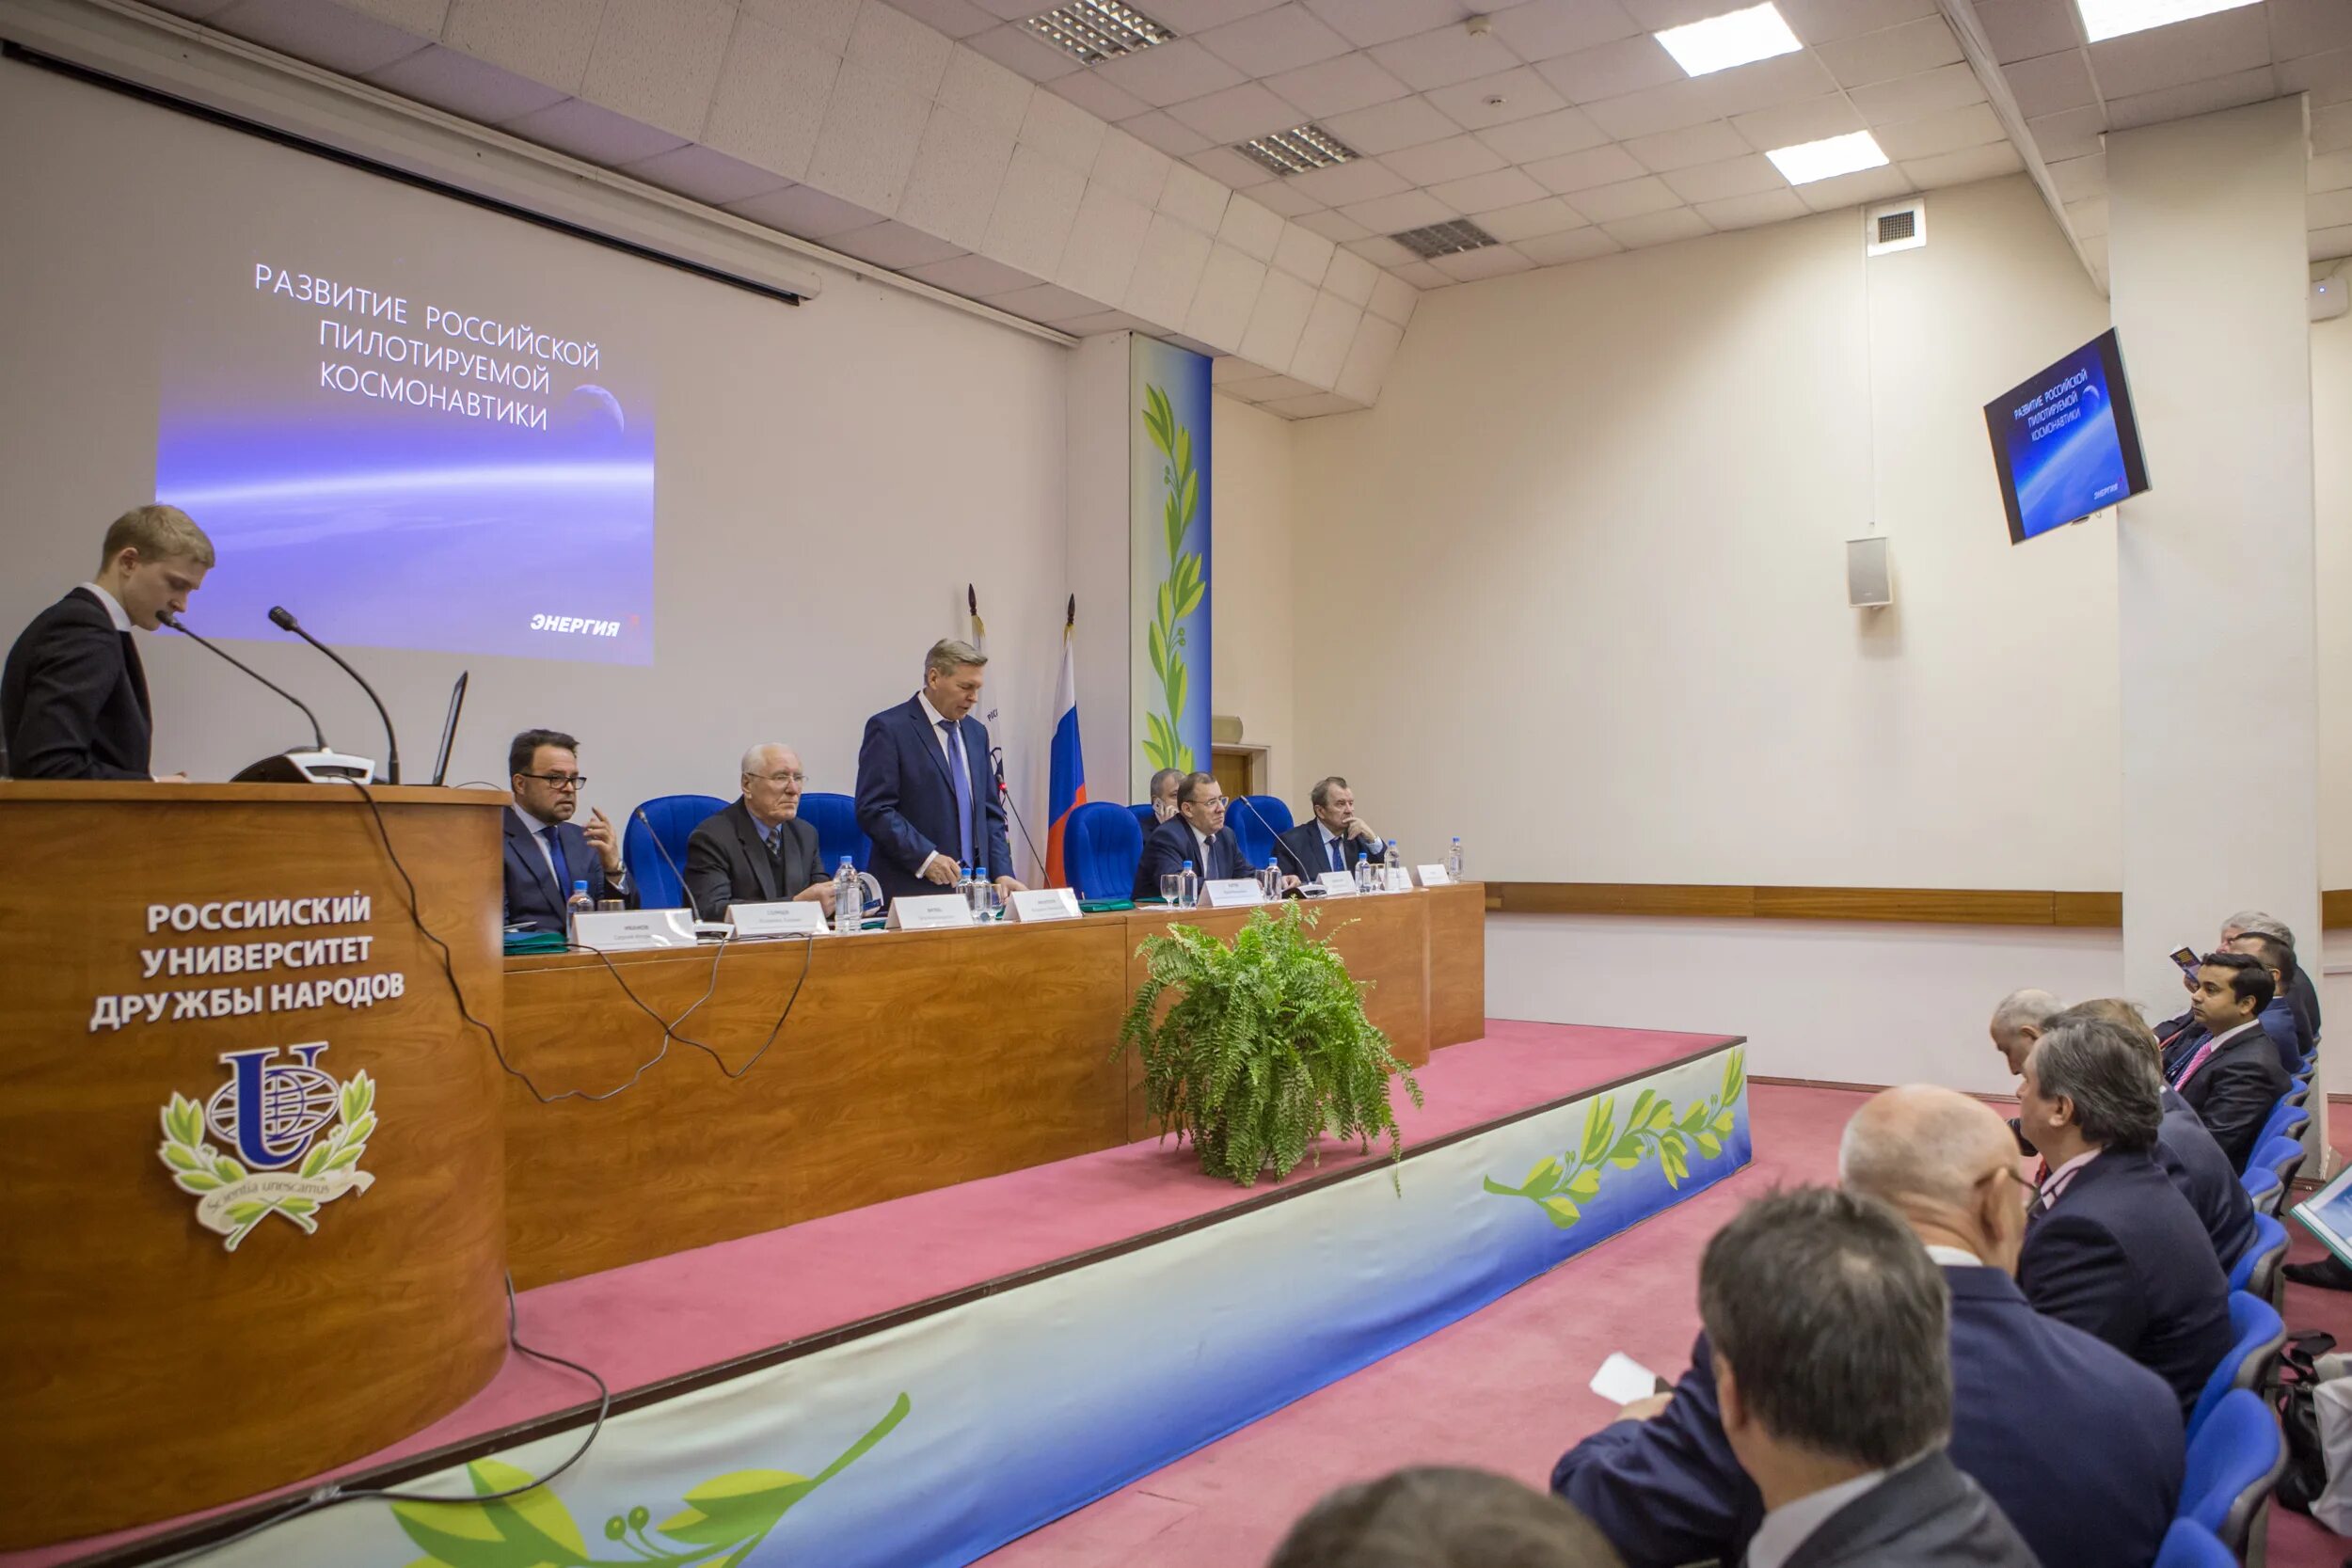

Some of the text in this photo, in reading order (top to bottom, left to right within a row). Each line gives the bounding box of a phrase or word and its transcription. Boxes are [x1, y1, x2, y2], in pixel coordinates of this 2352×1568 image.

[254, 262, 600, 371] РАЗВИТИЕ РОССИЙСКОЙ
[319, 320, 550, 395] ПИЛОТИРУЕМОЙ
[320, 361, 548, 432] КОСМОНАВТИКИ
[2014, 395, 2043, 420] РАЗВИТИЕ
[530, 613, 621, 638] ЭНЕРГИЯ
[140, 935, 373, 978] УНИВЕРСИТЕТ
[89, 973, 405, 1032] ДРУЖБЫ НАРОДОВ
